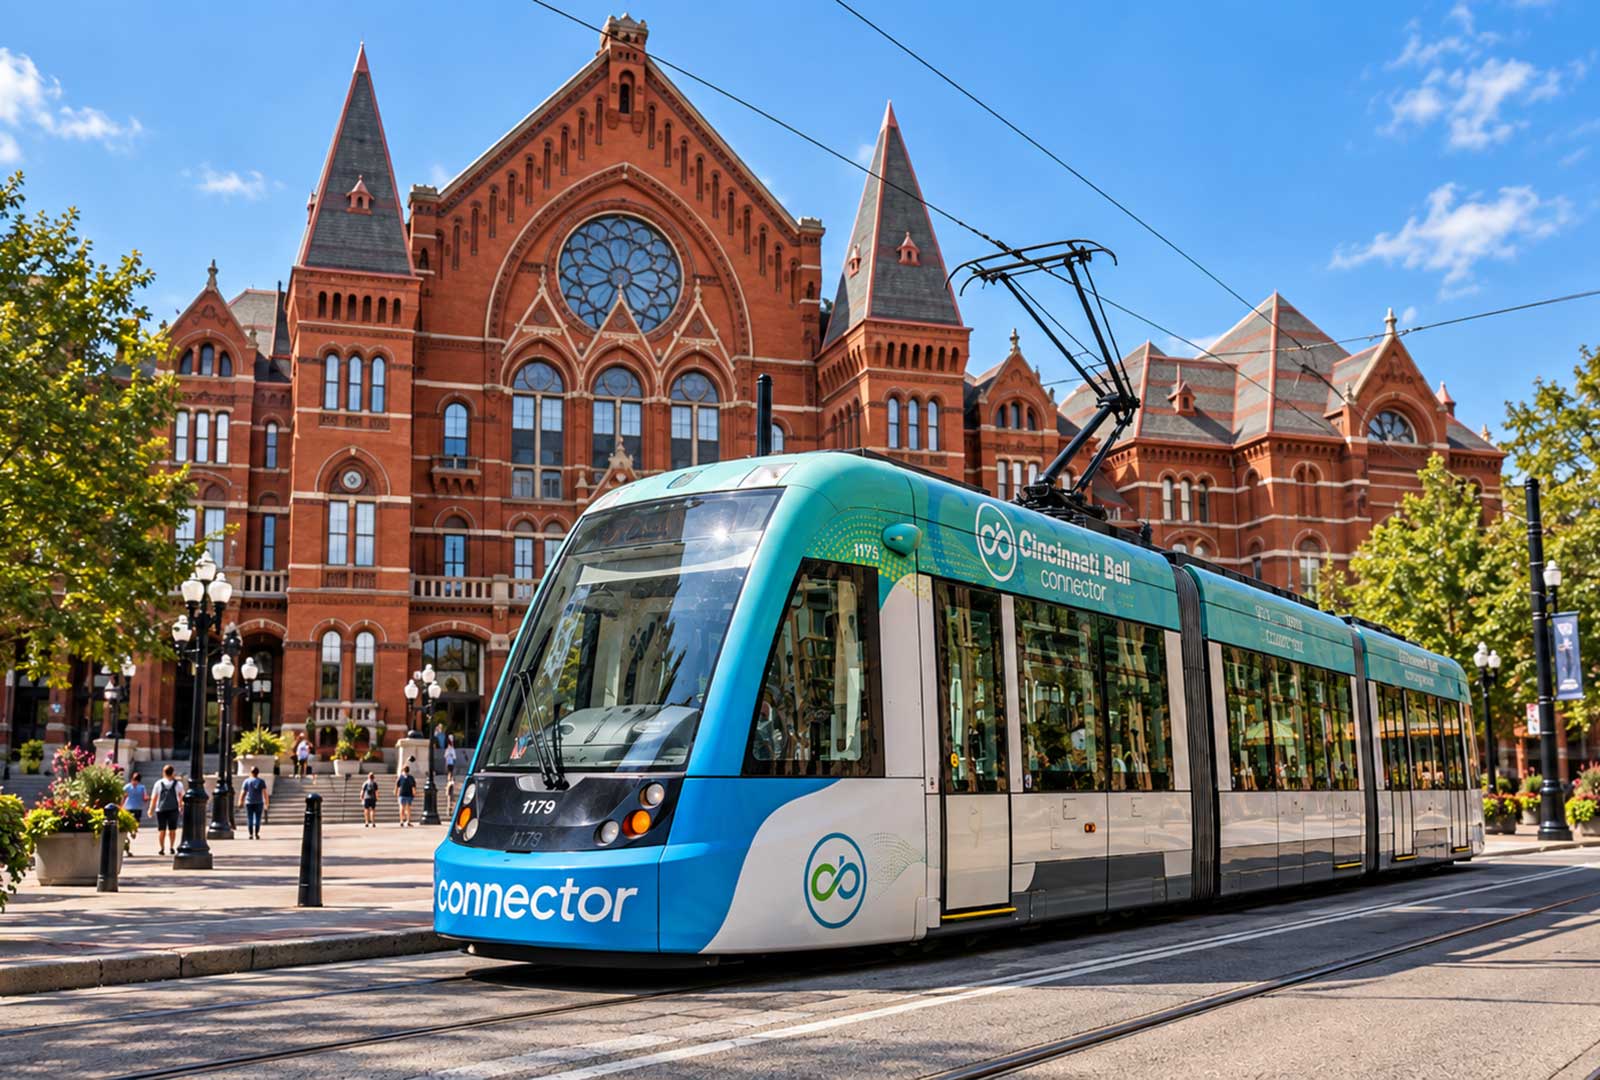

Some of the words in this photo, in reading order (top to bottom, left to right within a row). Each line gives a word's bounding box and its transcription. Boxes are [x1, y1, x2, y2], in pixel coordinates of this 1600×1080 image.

[1019, 529, 1100, 576] Cincinnati
[1103, 555, 1131, 585] Bell
[1041, 569, 1107, 600] connector
[522, 800, 556, 814] 1179
[437, 877, 638, 922] connector
